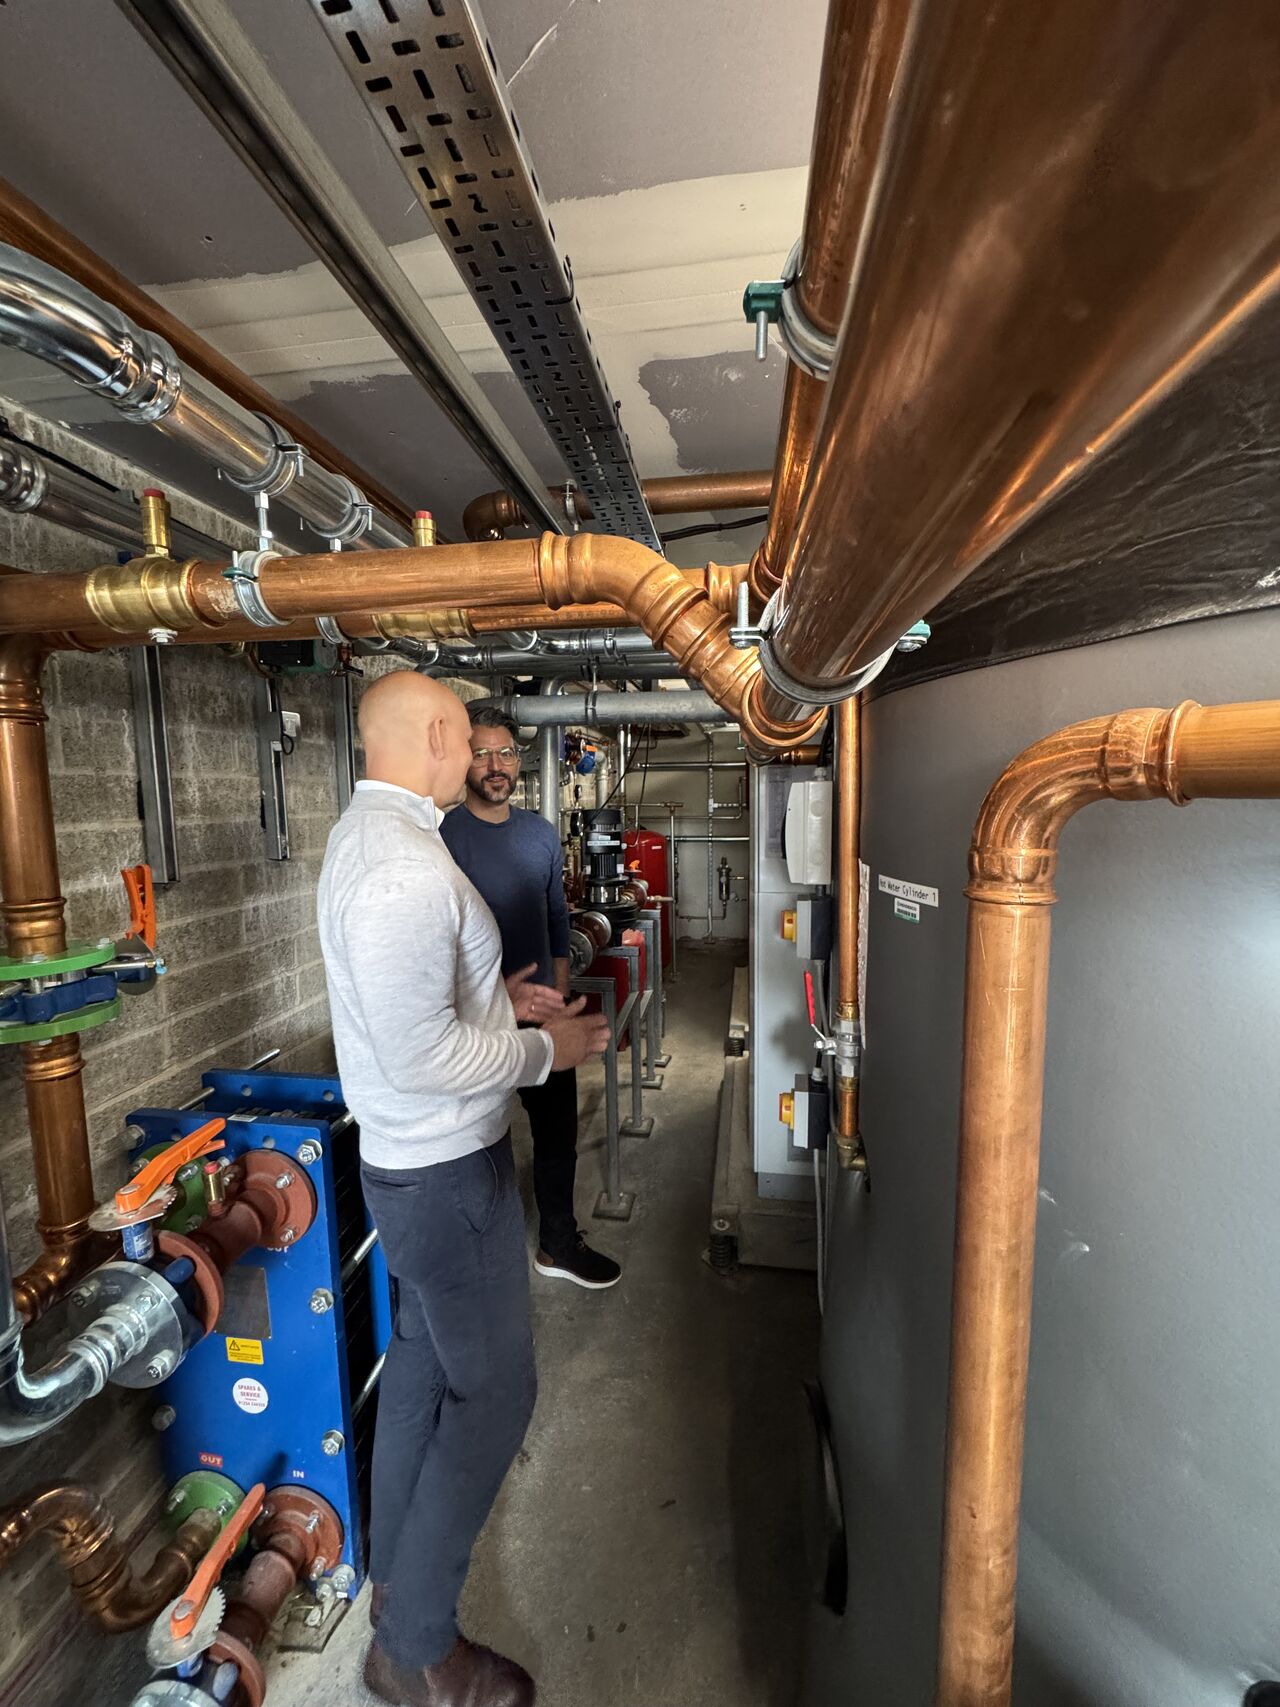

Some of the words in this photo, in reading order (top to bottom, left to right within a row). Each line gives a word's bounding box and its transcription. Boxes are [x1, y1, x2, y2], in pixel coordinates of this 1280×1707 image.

[888, 880, 900, 892] Water
[902, 884, 929, 900] Cylinder
[200, 1454, 222, 1466] OUT
[292, 1470, 304, 1478] IN
